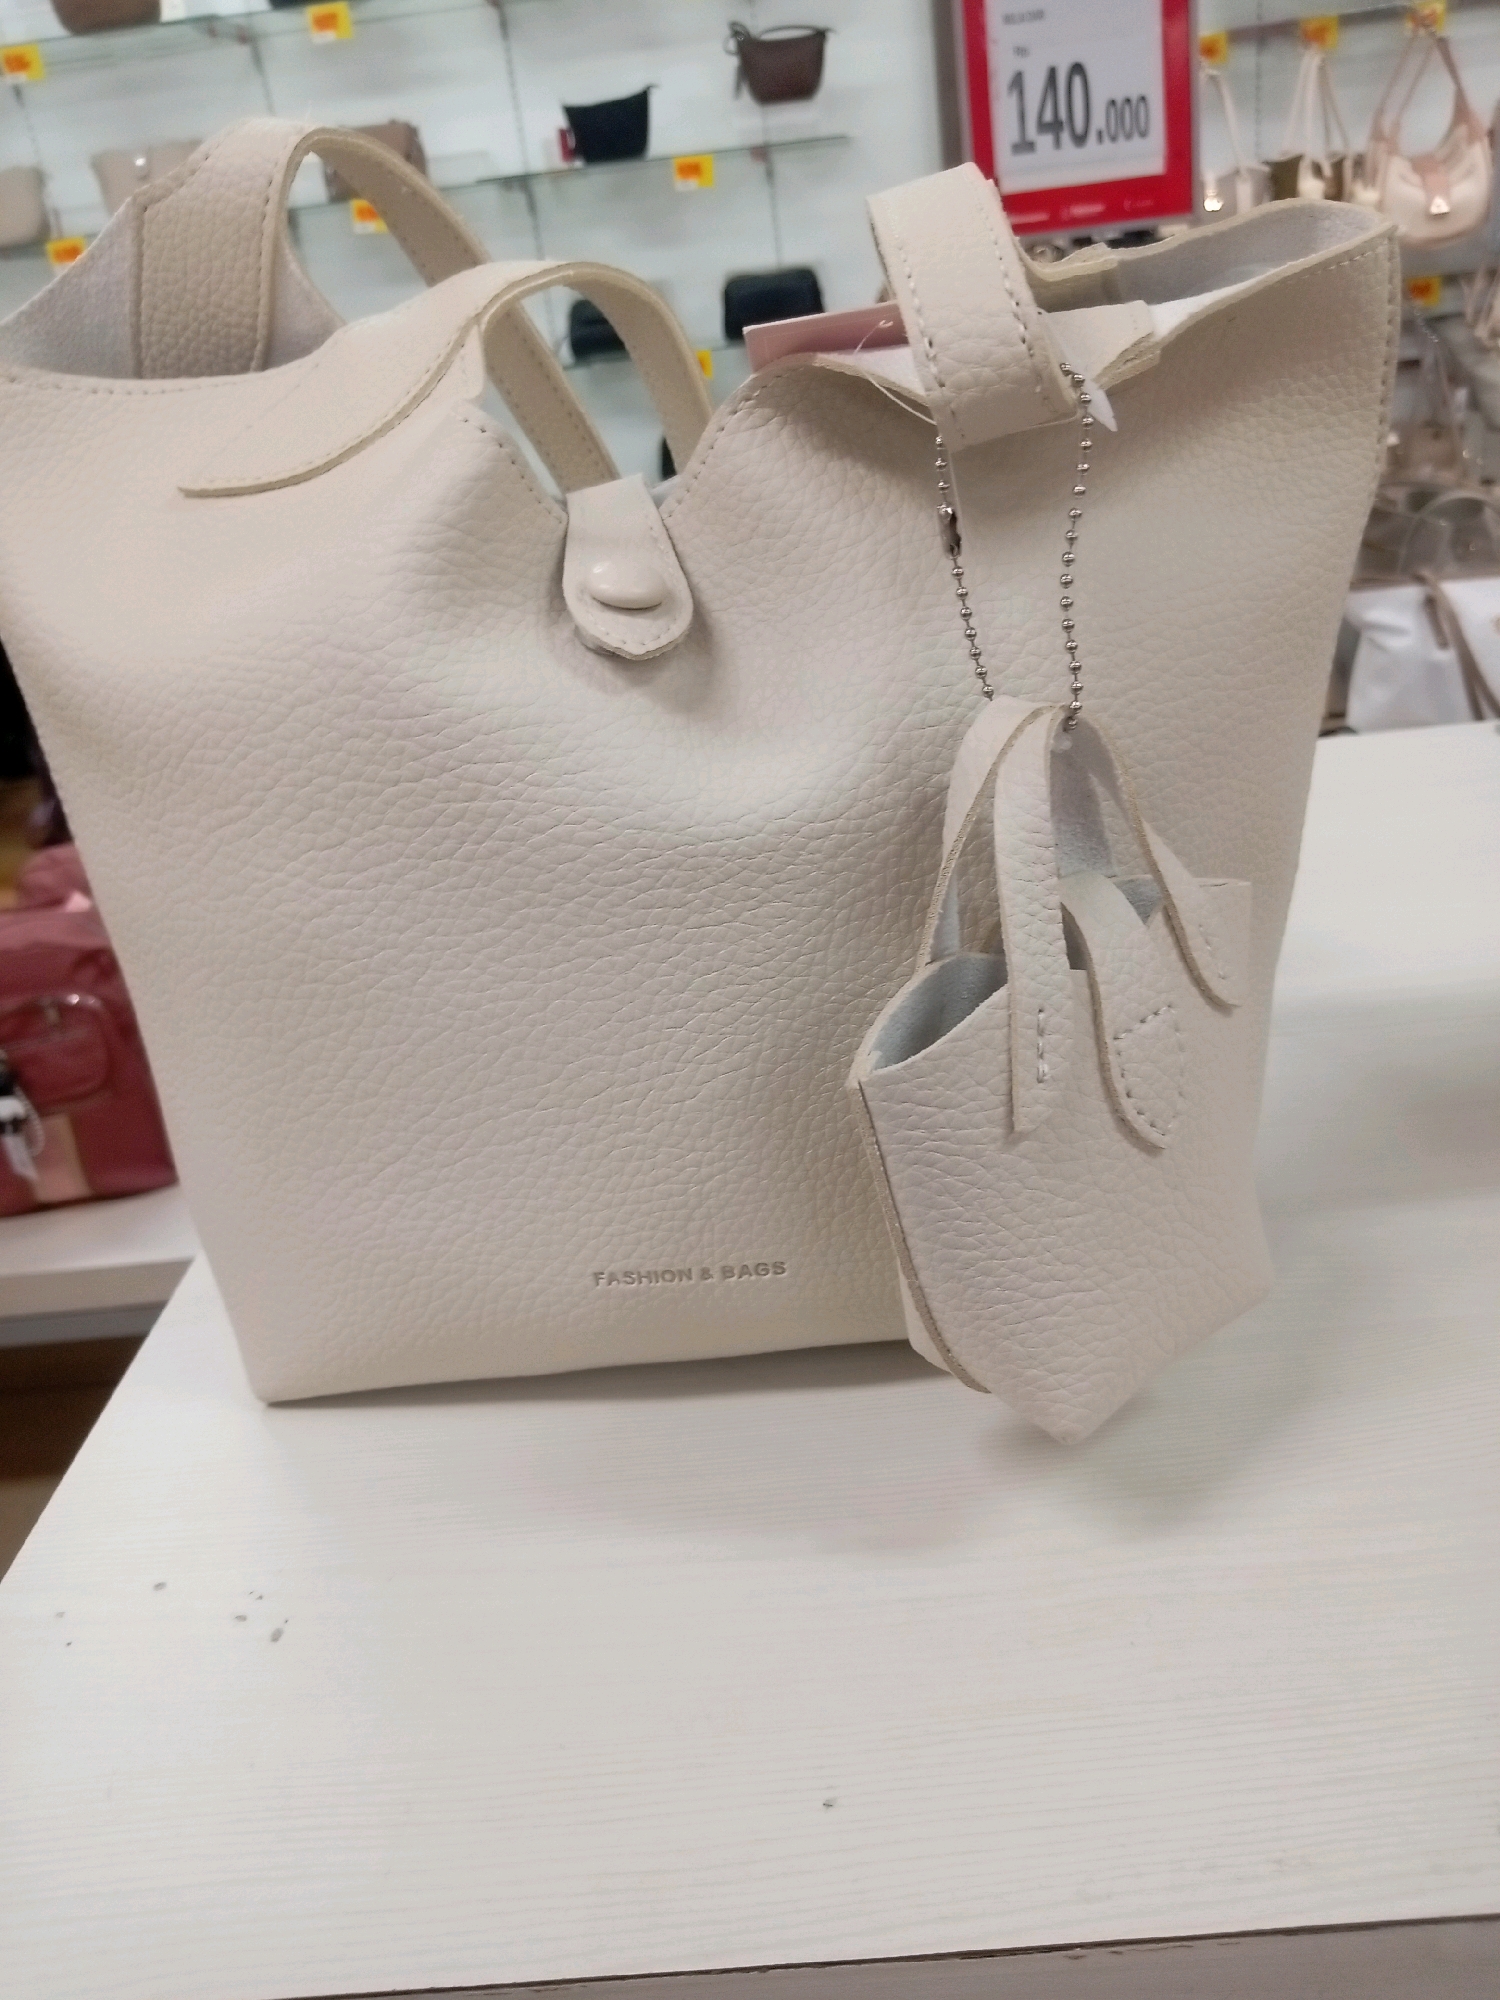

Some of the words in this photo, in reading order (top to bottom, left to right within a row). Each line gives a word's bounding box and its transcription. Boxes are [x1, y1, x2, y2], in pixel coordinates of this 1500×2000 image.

[1007, 61, 1150, 155] 140.000
[593, 1268, 694, 1287] FASHION
[700, 1265, 715, 1281] &
[720, 1260, 788, 1281] BAGS
